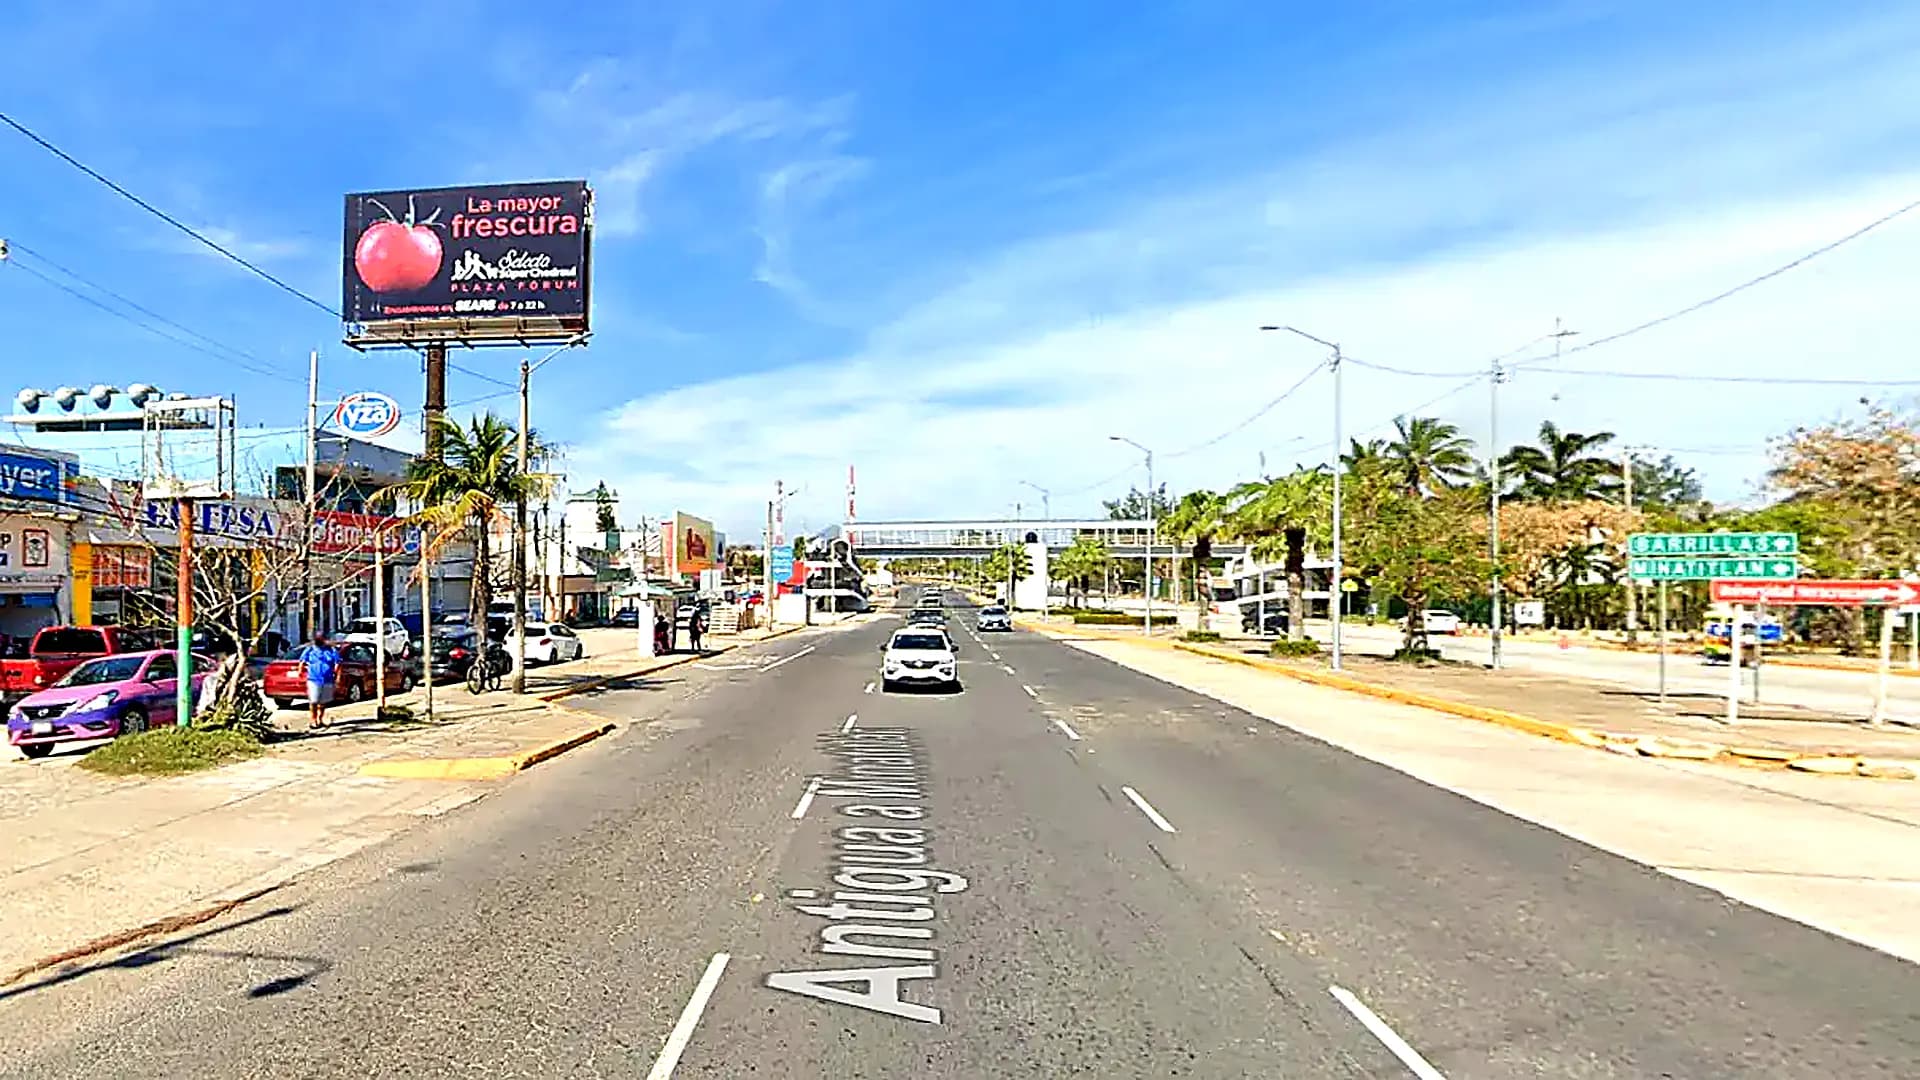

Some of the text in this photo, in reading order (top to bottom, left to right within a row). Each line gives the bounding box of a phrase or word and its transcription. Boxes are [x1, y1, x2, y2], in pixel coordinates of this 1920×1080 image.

[467, 196, 562, 214] La mayor
[451, 213, 577, 238] frescura
[450, 280, 578, 292] PLAZA FORUM
[455, 299, 496, 312] SEARS
[1635, 536, 1769, 551] BARRILLAS
[1633, 559, 1765, 576] MINATITLAN
